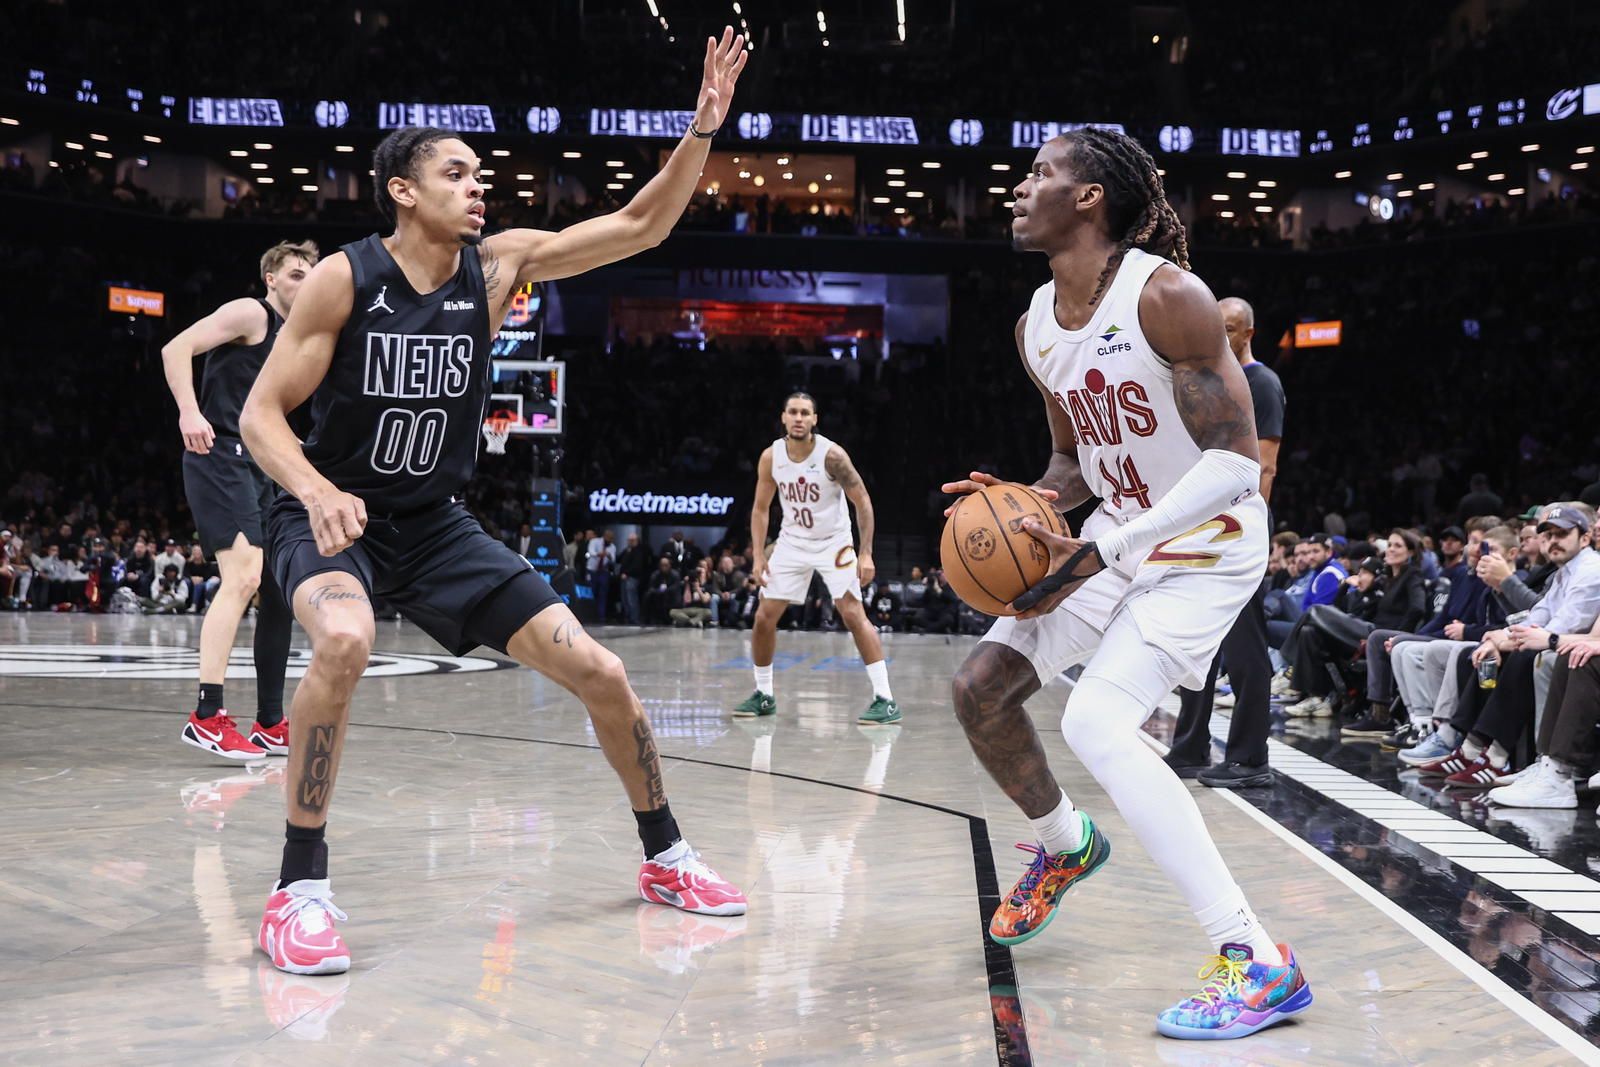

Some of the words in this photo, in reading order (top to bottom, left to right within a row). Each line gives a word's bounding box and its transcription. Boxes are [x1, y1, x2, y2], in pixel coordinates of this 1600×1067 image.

[384, 103, 492, 129] DEFENSE
[808, 116, 914, 142] DEFENSE
[499, 330, 536, 341] TISSOT
[1097, 342, 1132, 356] CLIFFS
[363, 332, 474, 398] NETS
[371, 408, 447, 475] 00
[780, 481, 820, 503] CAVS
[1100, 454, 1152, 509] 14
[589, 488, 734, 515] ticketmaster
[792, 506, 814, 529] 20
[303, 727, 334, 806] NOW
